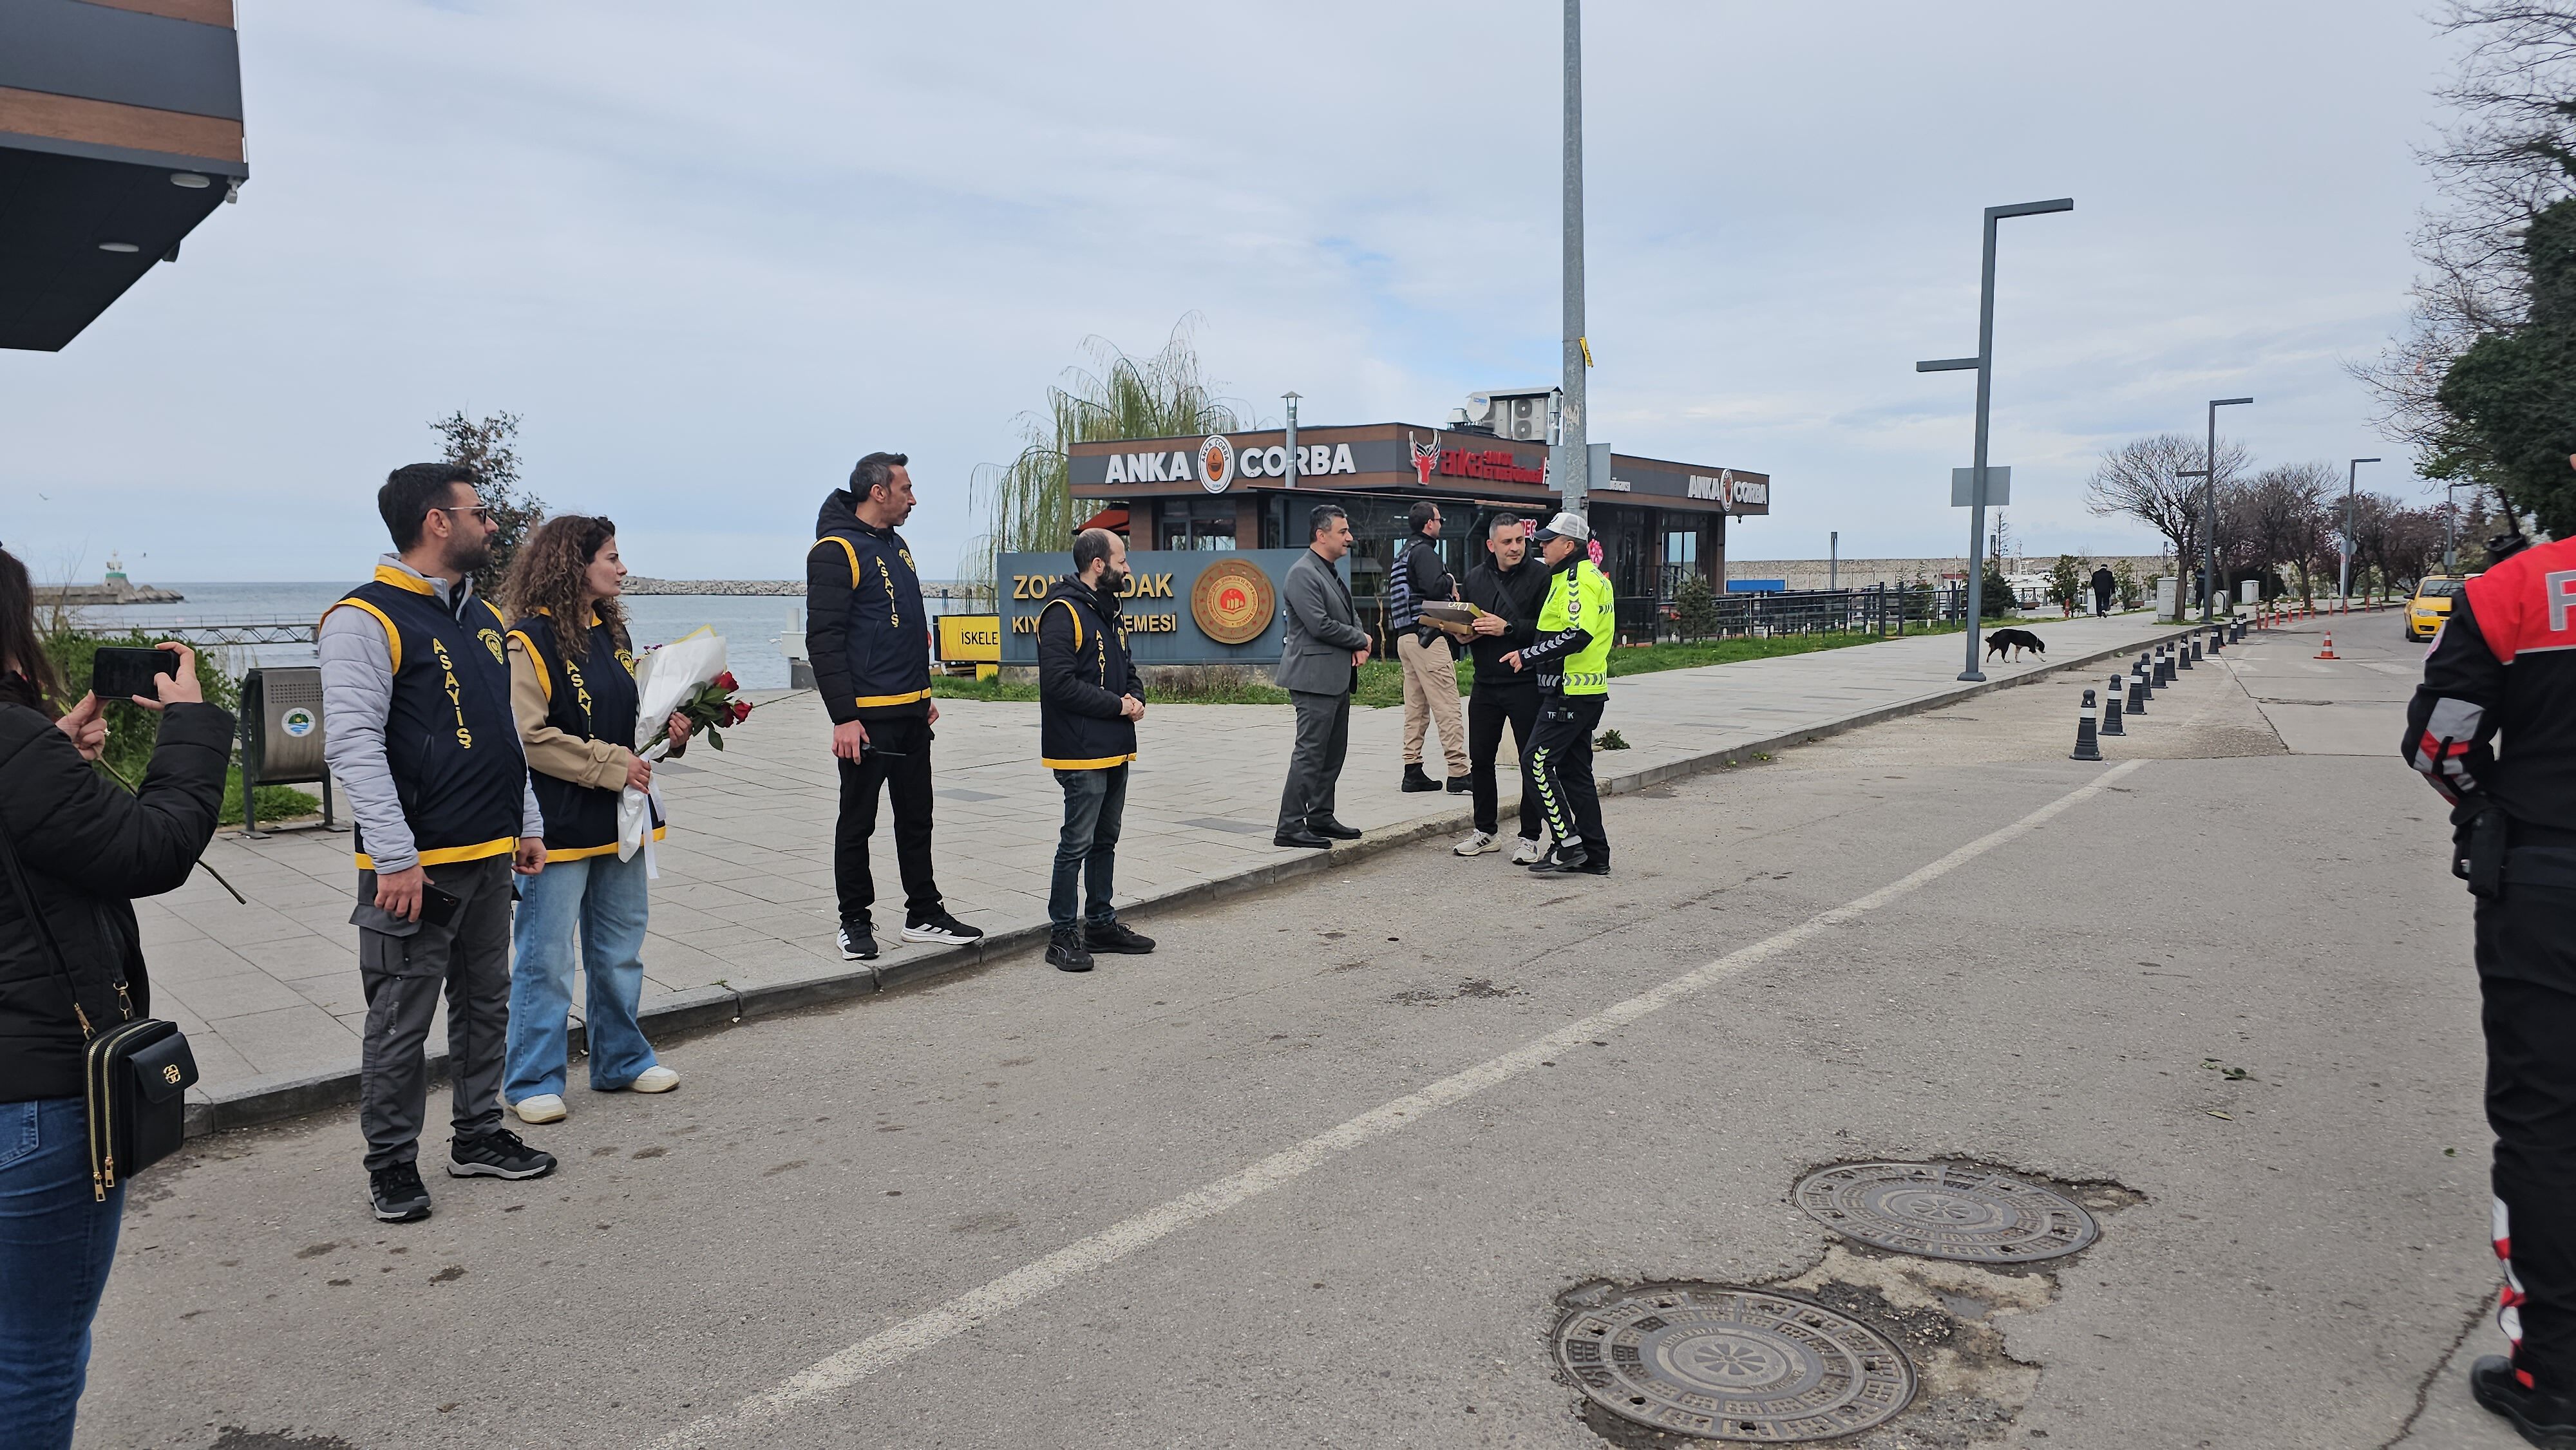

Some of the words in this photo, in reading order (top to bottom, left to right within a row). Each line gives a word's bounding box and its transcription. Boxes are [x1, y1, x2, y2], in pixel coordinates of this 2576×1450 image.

[1202, 442, 1212, 462] ANKA
[1215, 439, 1229, 462] ÇORBA
[1104, 451, 1193, 484] ANKA
[1240, 444, 1356, 478] ÇORBA
[1687, 475, 1721, 501] ANKA
[1519, 519, 1537, 541] EÇ
[876, 556, 900, 628] ASAYİŞ
[1013, 573, 1173, 599] ZODAK
[1012, 616, 1039, 634] KIY
[1124, 612, 1177, 633] EMESİ
[961, 628, 998, 645] İSKELE
[1096, 630, 1106, 690] ASAYİ
[433, 638, 472, 749] ASAYİŞ
[566, 659, 595, 739] ASAYİ
